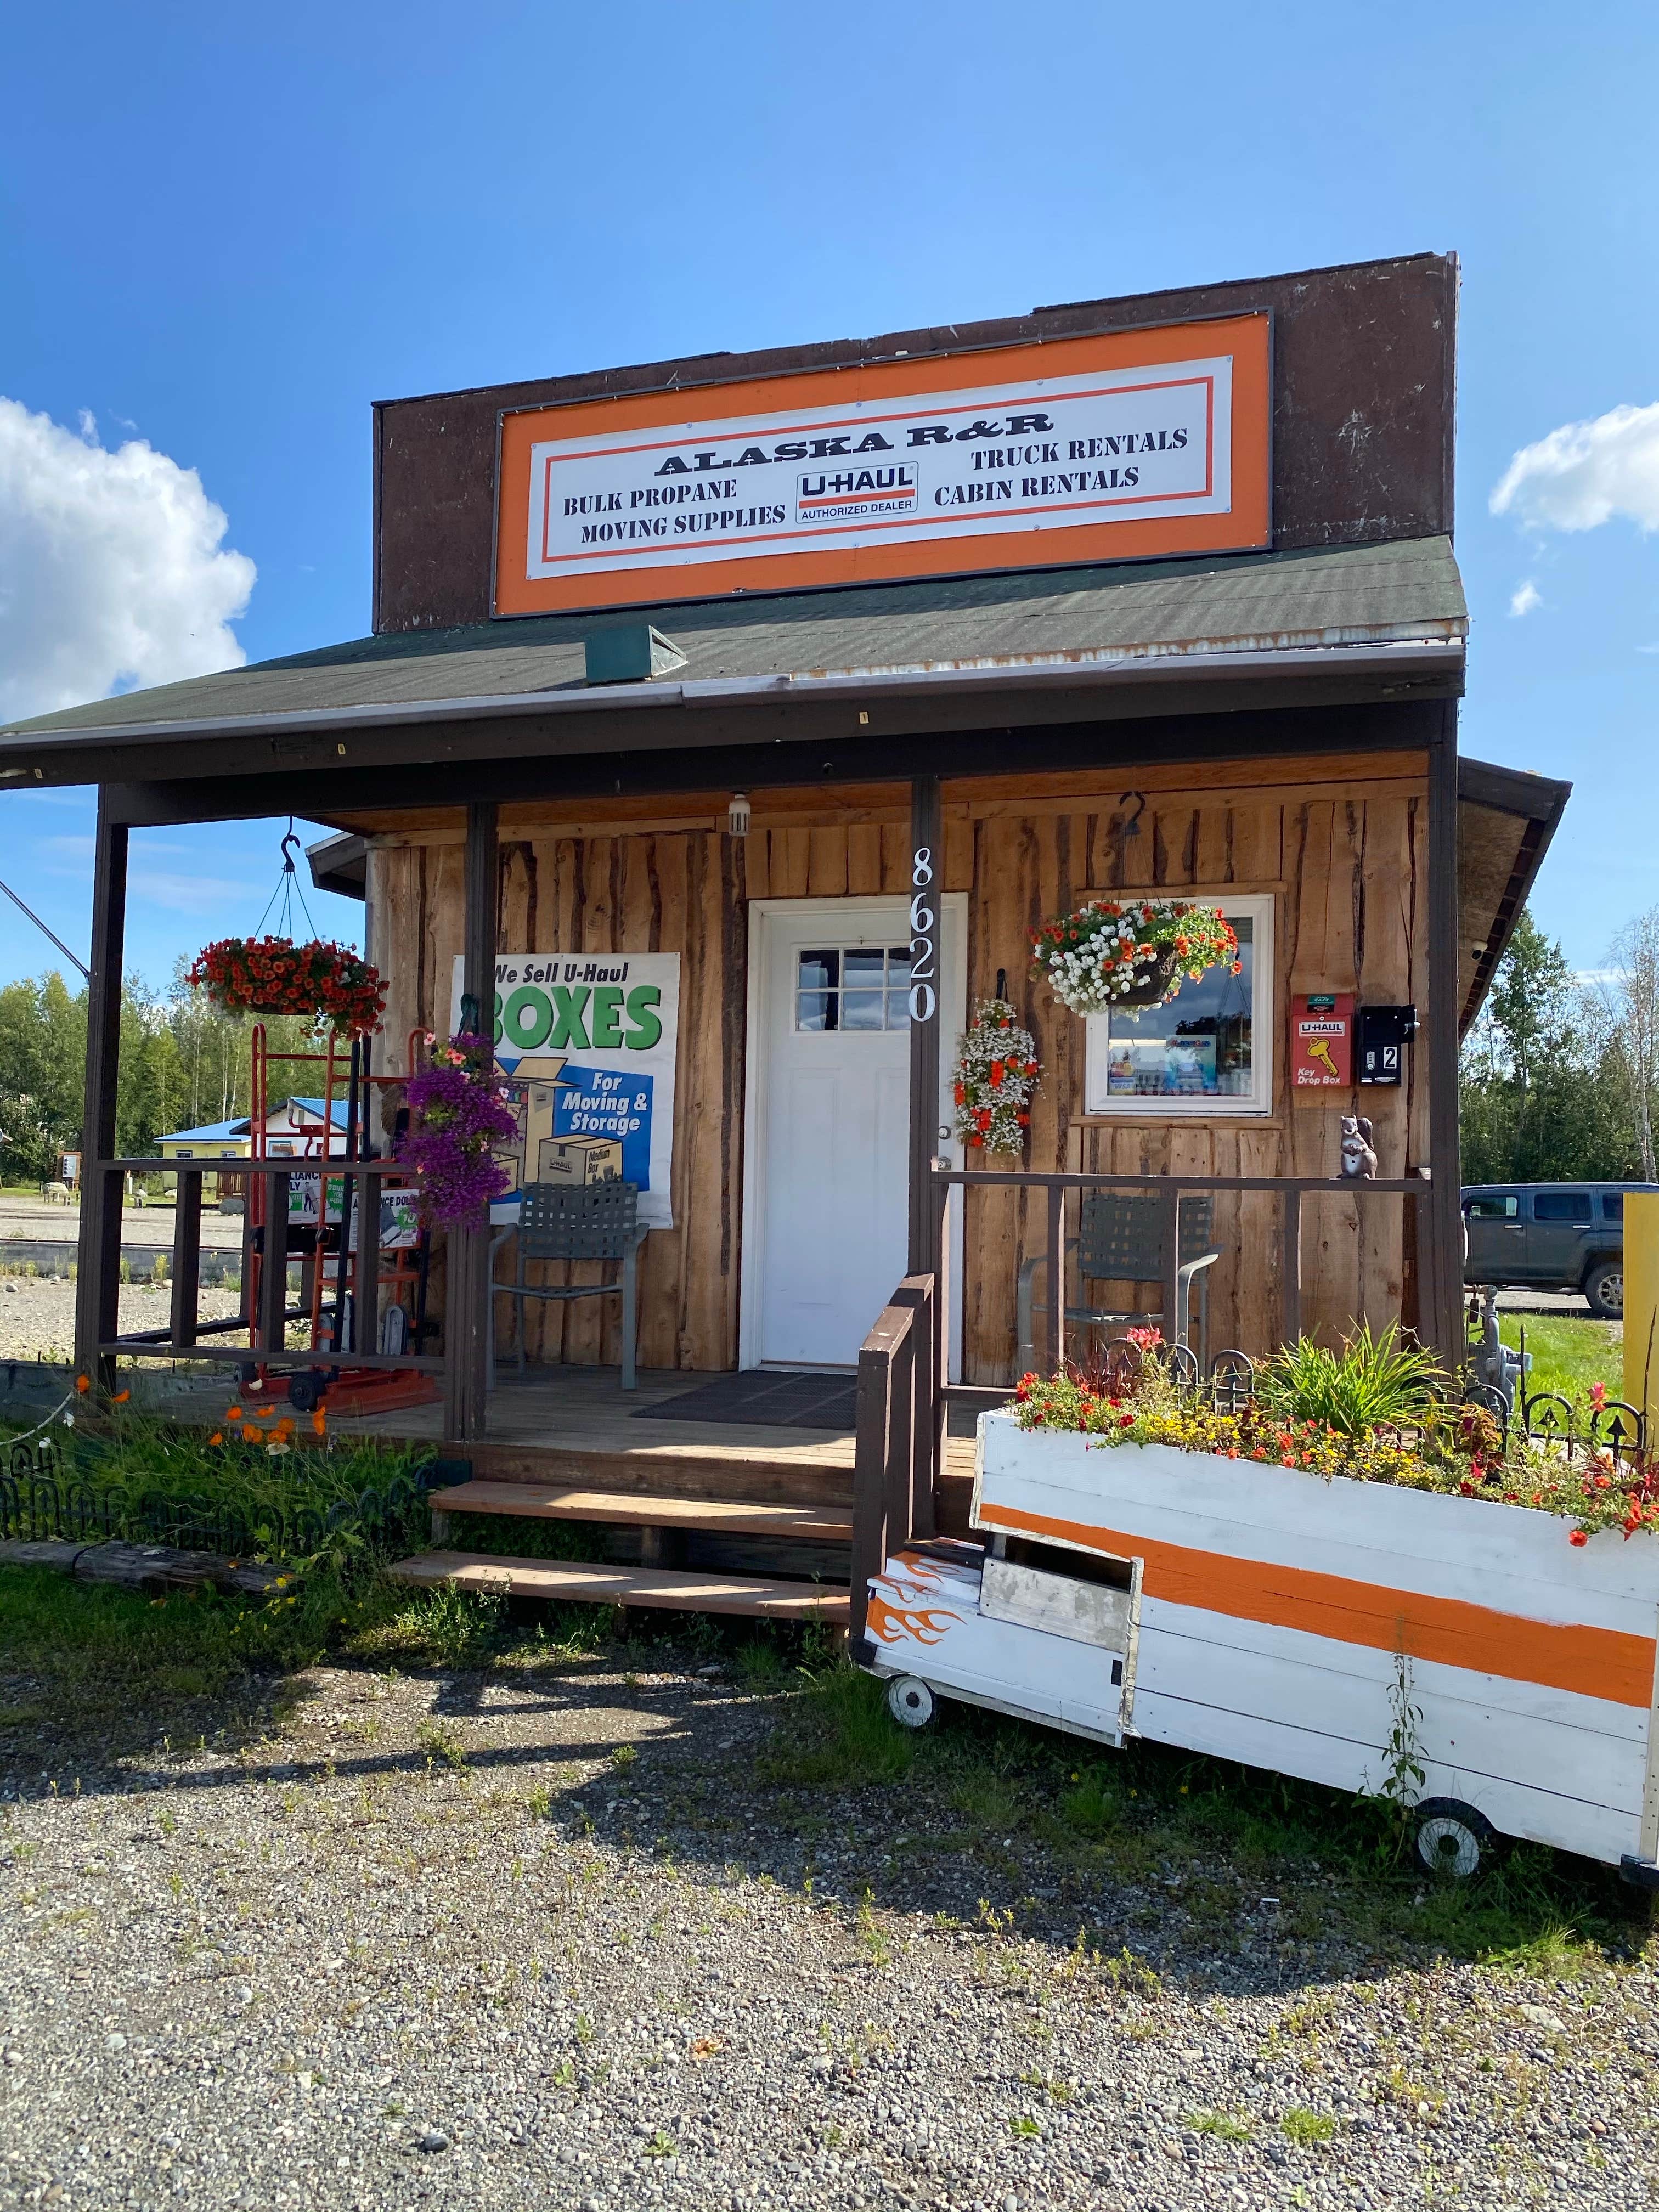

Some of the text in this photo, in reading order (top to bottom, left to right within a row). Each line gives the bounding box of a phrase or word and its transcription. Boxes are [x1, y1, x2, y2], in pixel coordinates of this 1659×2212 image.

[654, 413, 1054, 476] ALASKA R&R
[970, 428, 1188, 470] TRUCK RENTALS
[802, 467, 913, 496] U-HAUL
[934, 466, 1139, 506] CABIN RENTALS
[563, 479, 737, 516] BULK PROPANE
[802, 500, 912, 520] AUTHORIZED DEALER
[581, 504, 786, 544] MOVING SUPPLIES
[909, 847, 935, 1022] 8620
[495, 962, 630, 983] We Sell U-Haul
[493, 985, 662, 1050] OXES
[1302, 1023, 1342, 1031] U-HAUL
[1385, 1048, 1395, 1068] 2
[592, 1072, 622, 1091] For
[1298, 1068, 1315, 1077] Key
[1298, 1076, 1320, 1085] Drop
[562, 1091, 647, 1116] Moving &
[570, 1112, 640, 1136] Storage
[588, 1163, 599, 1174] Box
